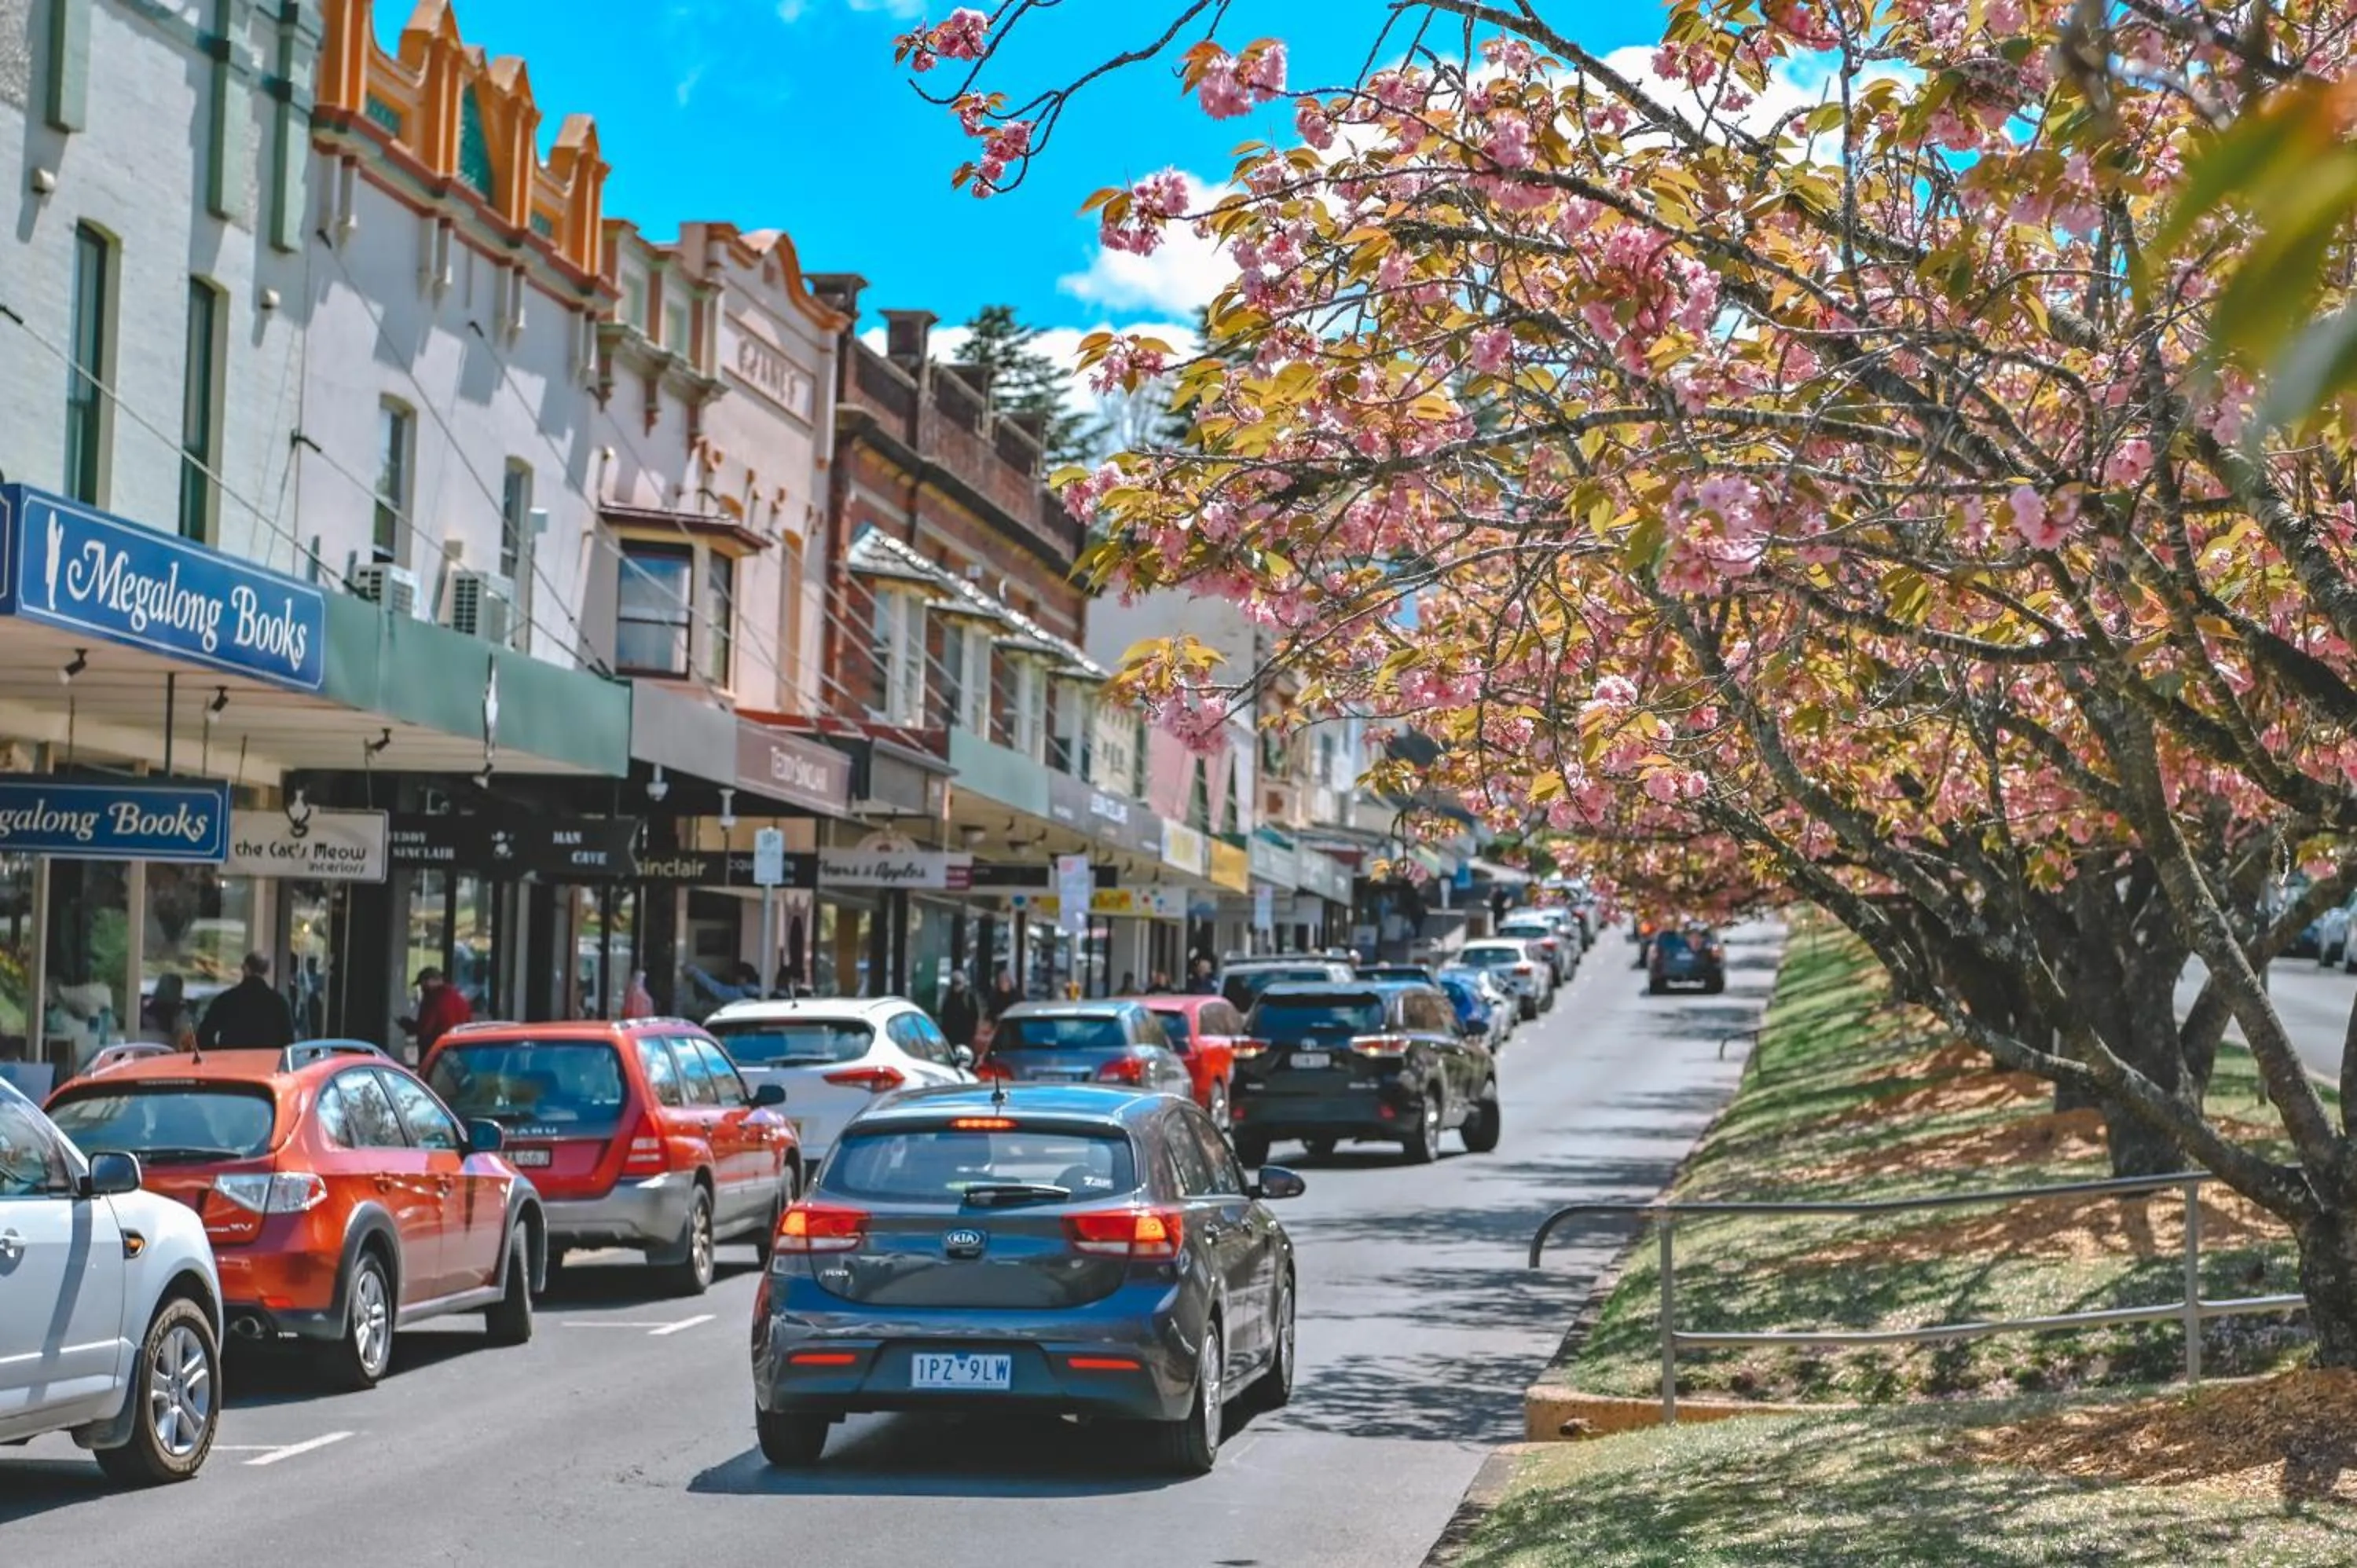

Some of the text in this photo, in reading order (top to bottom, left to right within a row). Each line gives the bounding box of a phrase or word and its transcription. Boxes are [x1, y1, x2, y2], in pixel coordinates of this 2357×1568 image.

[68, 540, 307, 672] Megalong Books
[108, 801, 208, 843] Books
[314, 842, 366, 860] Meow
[393, 846, 455, 859] SINCLAIR
[571, 851, 607, 866] CAVE
[952, 1232, 974, 1244] KIA
[918, 1358, 1008, 1381] 1PZ 9LW
